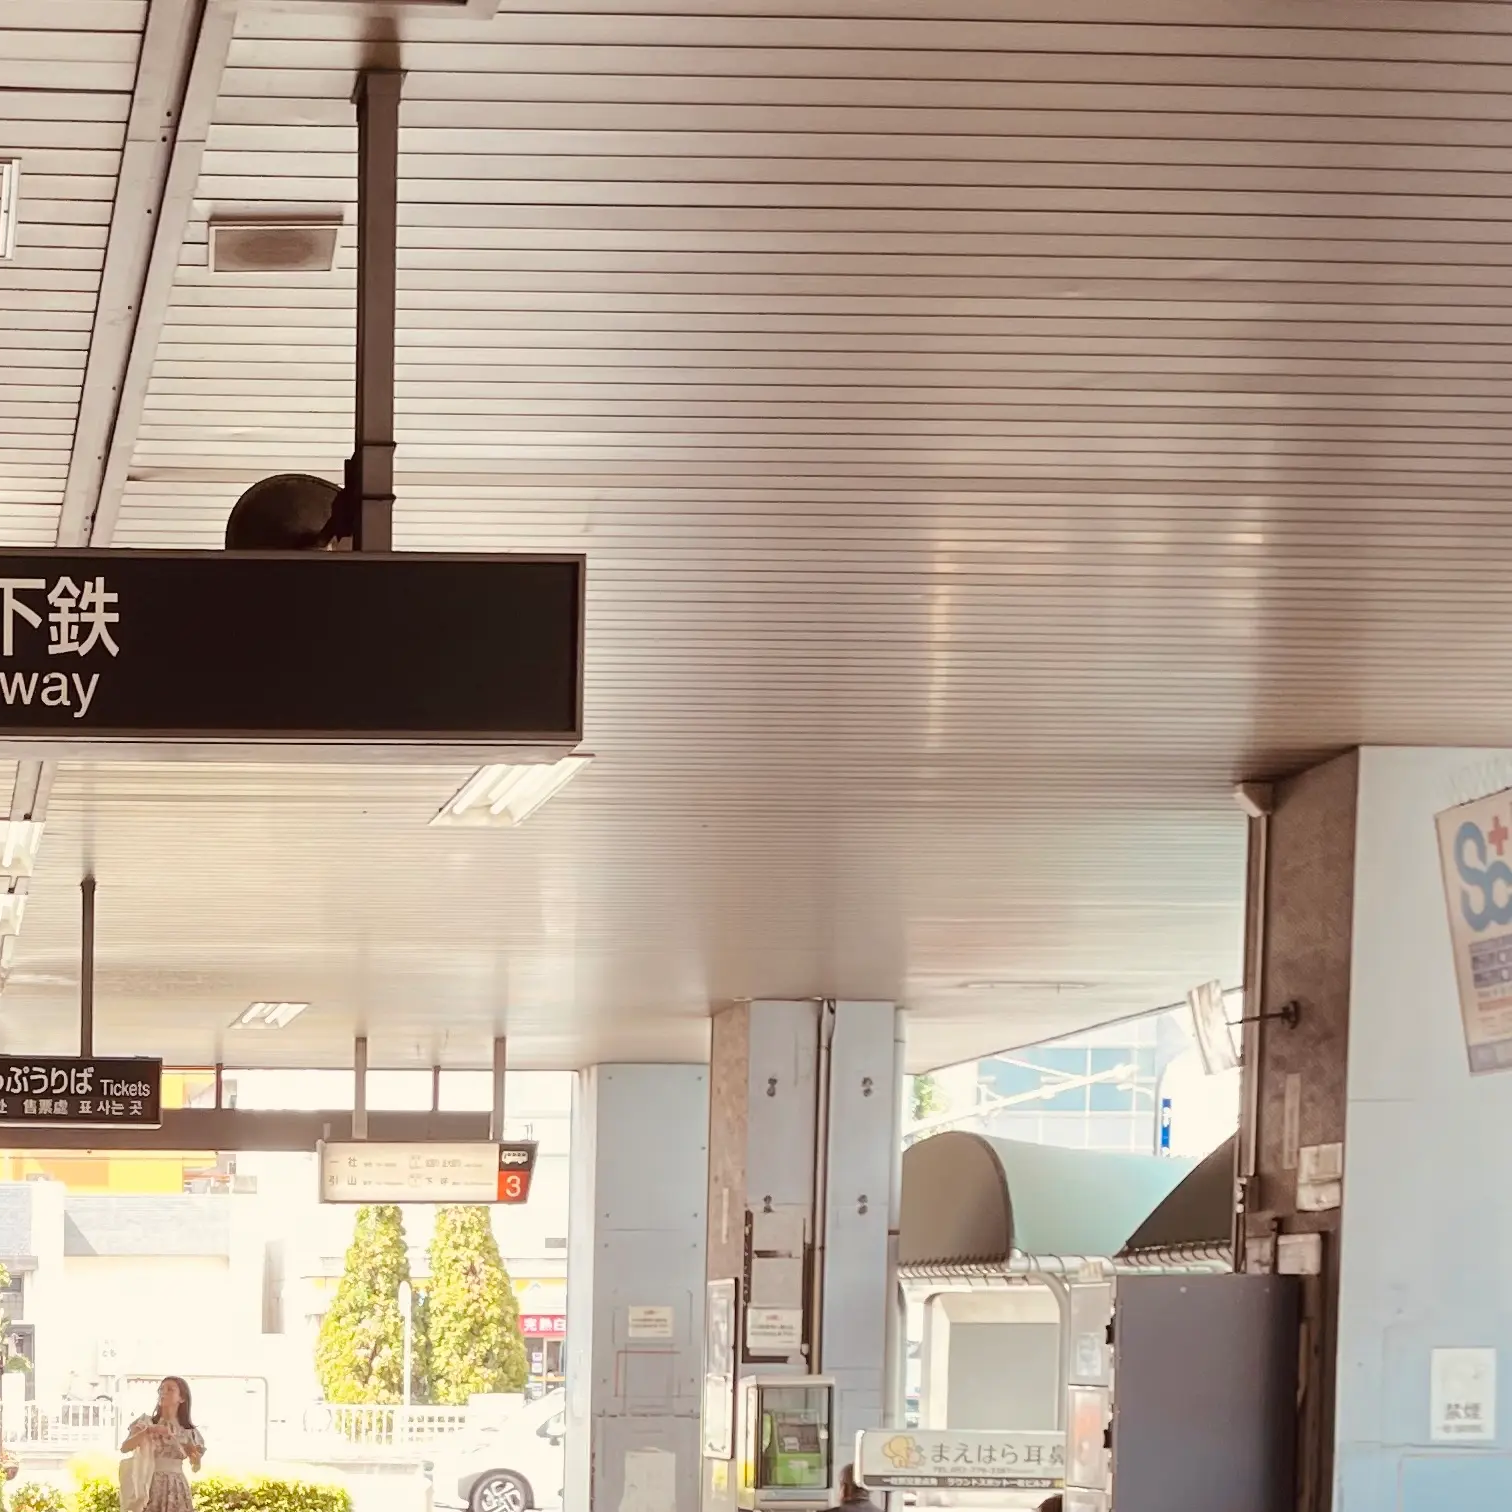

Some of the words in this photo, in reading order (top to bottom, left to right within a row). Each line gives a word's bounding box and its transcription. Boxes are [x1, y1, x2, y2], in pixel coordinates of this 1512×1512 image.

[100, 1080, 150, 1097] Tickets
[78, 1100, 93, 1115] 표
[97, 1101, 124, 1116] 사는
[129, 1101, 143, 1116] 곳
[505, 1176, 521, 1197] 3
